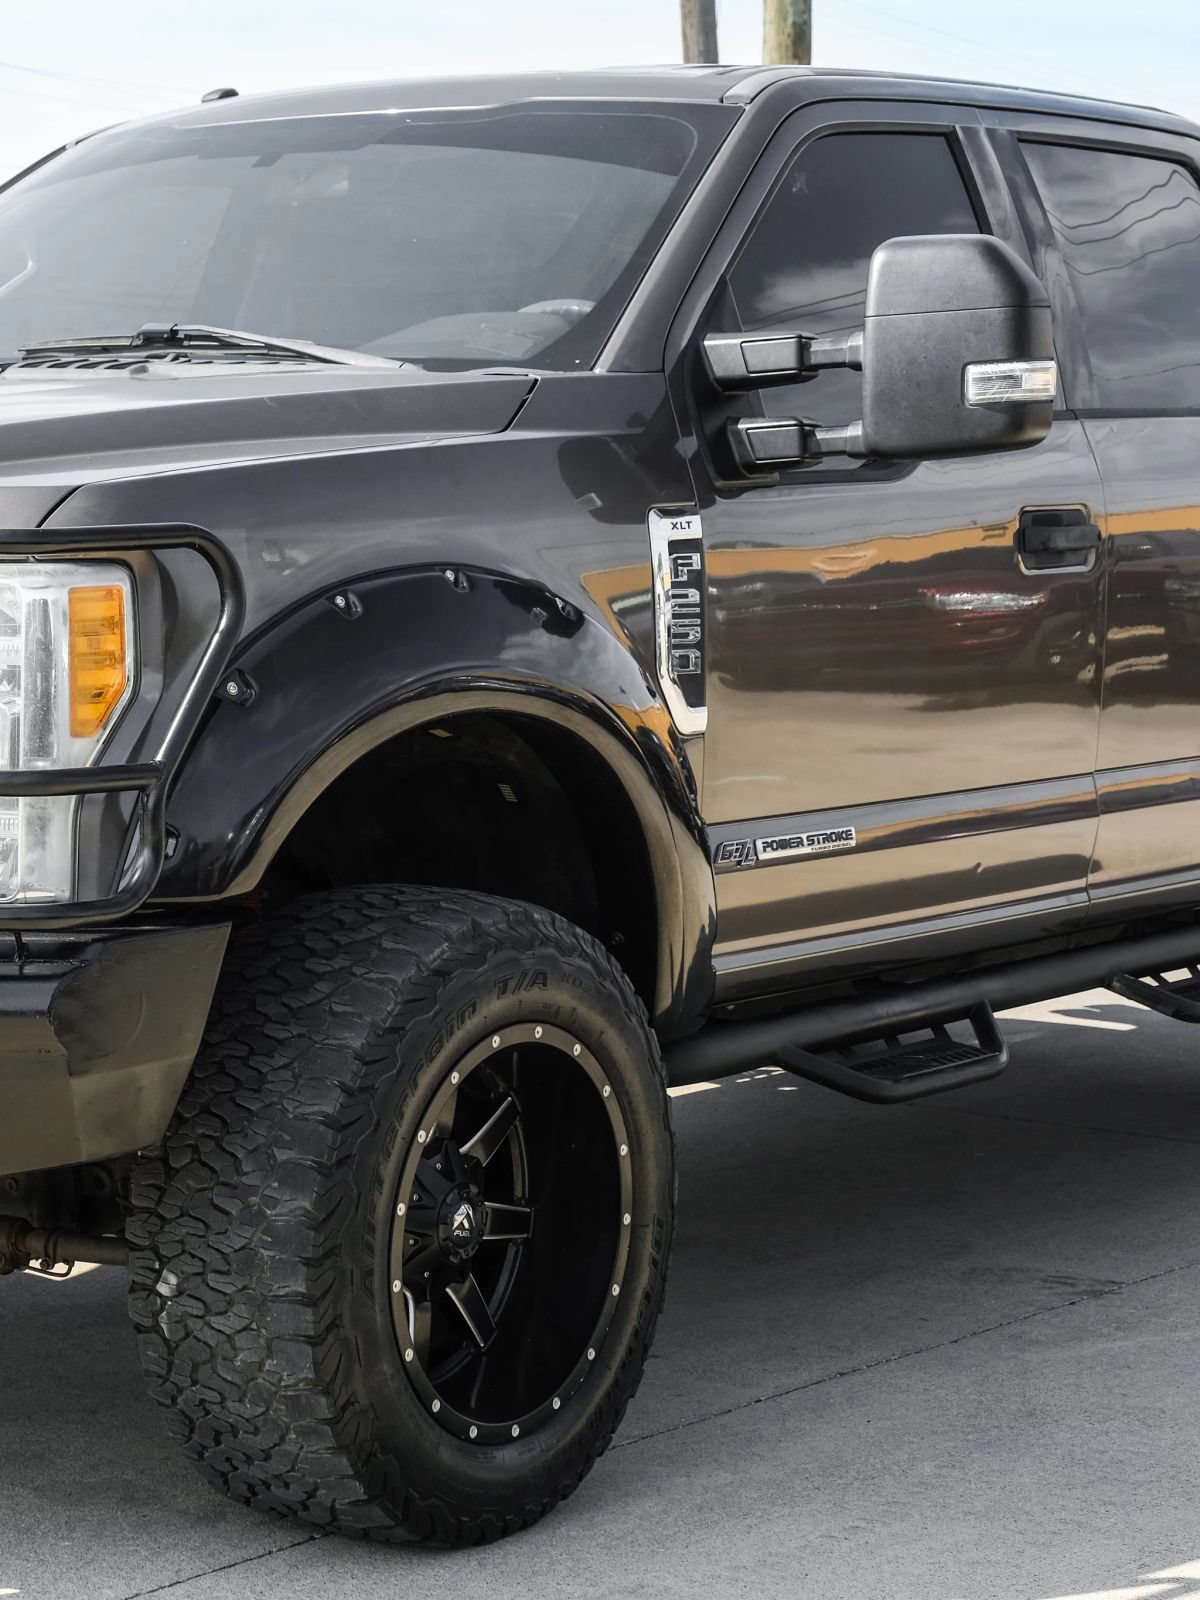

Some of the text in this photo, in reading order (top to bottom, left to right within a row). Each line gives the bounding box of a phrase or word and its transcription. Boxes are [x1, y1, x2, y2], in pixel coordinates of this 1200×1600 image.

[670, 521, 693, 530] XLT
[761, 836, 805, 853] POWER
[805, 829, 854, 847] STROKE
[810, 842, 853, 852] TURBO DIESEL
[453, 1230, 472, 1238] FUEL
